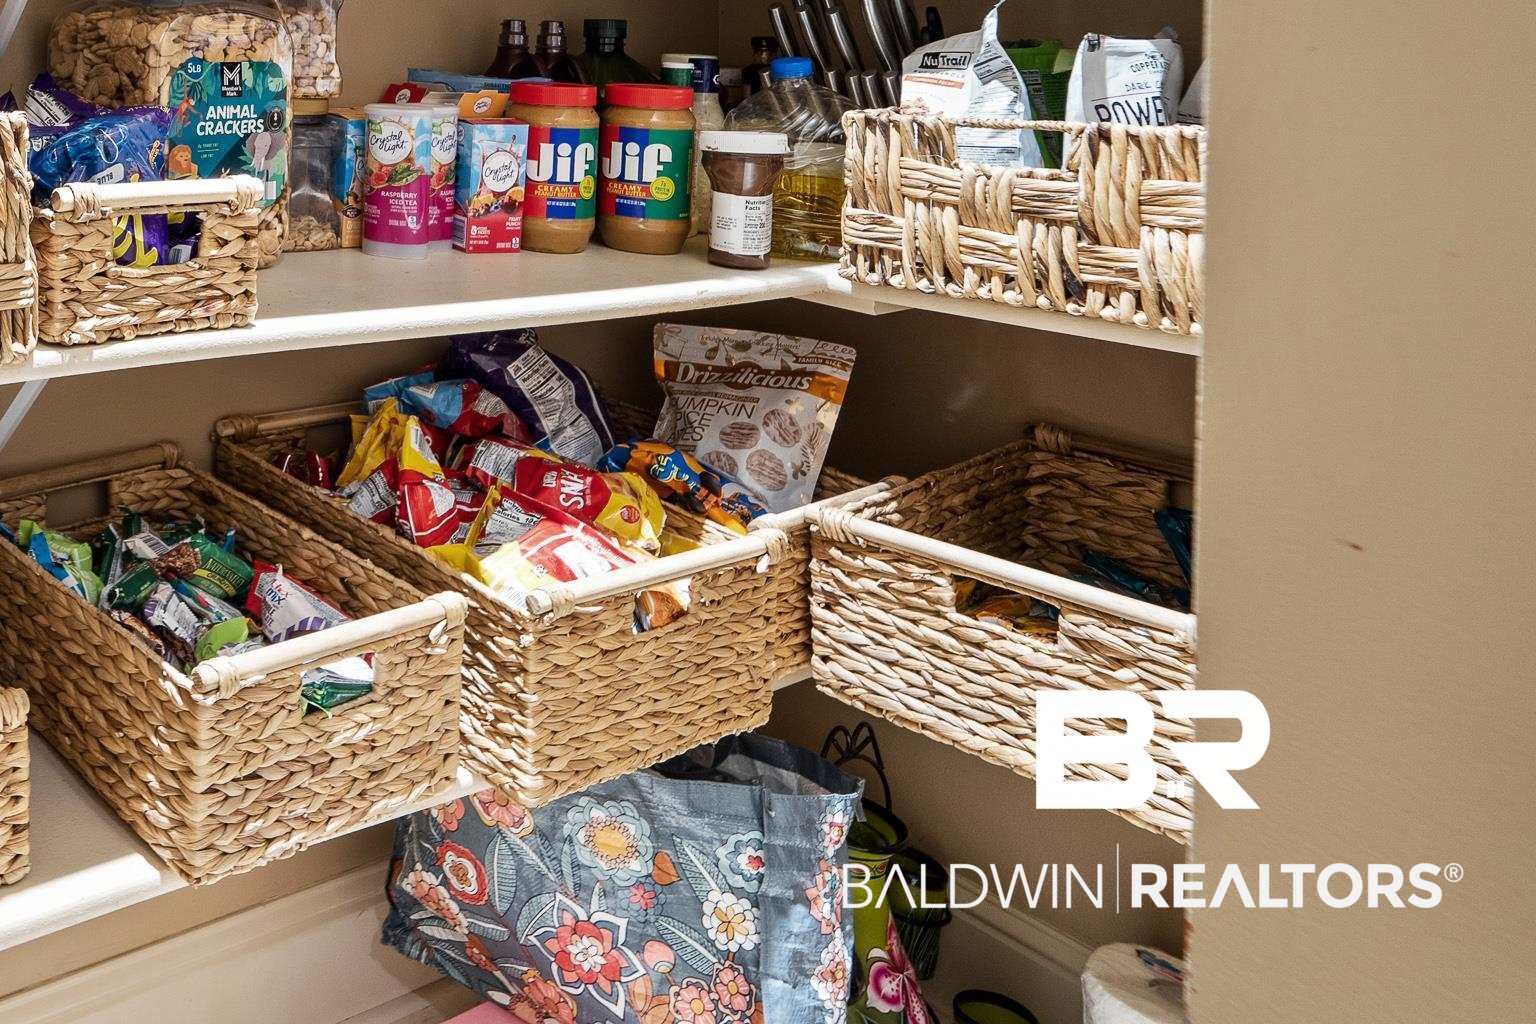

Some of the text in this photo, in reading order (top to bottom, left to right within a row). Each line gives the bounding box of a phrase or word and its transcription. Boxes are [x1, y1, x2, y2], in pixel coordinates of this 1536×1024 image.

[187, 63, 202, 74] 5LB
[921, 53, 969, 69] NuTrail
[1130, 61, 1157, 73] COPPER
[1125, 80, 1151, 93] DARK
[206, 104, 258, 121] ANIMAL
[196, 119, 265, 137] CRACKERS
[370, 130, 404, 153] Crystal
[383, 140, 406, 156] Light
[526, 142, 595, 183] Jif
[602, 141, 673, 182] Jif
[484, 159, 512, 181] Crystal
[492, 170, 514, 184] Light
[381, 190, 418, 198] RASPBERRY
[537, 184, 574, 193] CREAMY
[608, 182, 642, 192] CREAMY
[797, 355, 824, 365] FAMILY
[675, 362, 813, 391] Drizzilicious
[266, 588, 286, 606] mix
